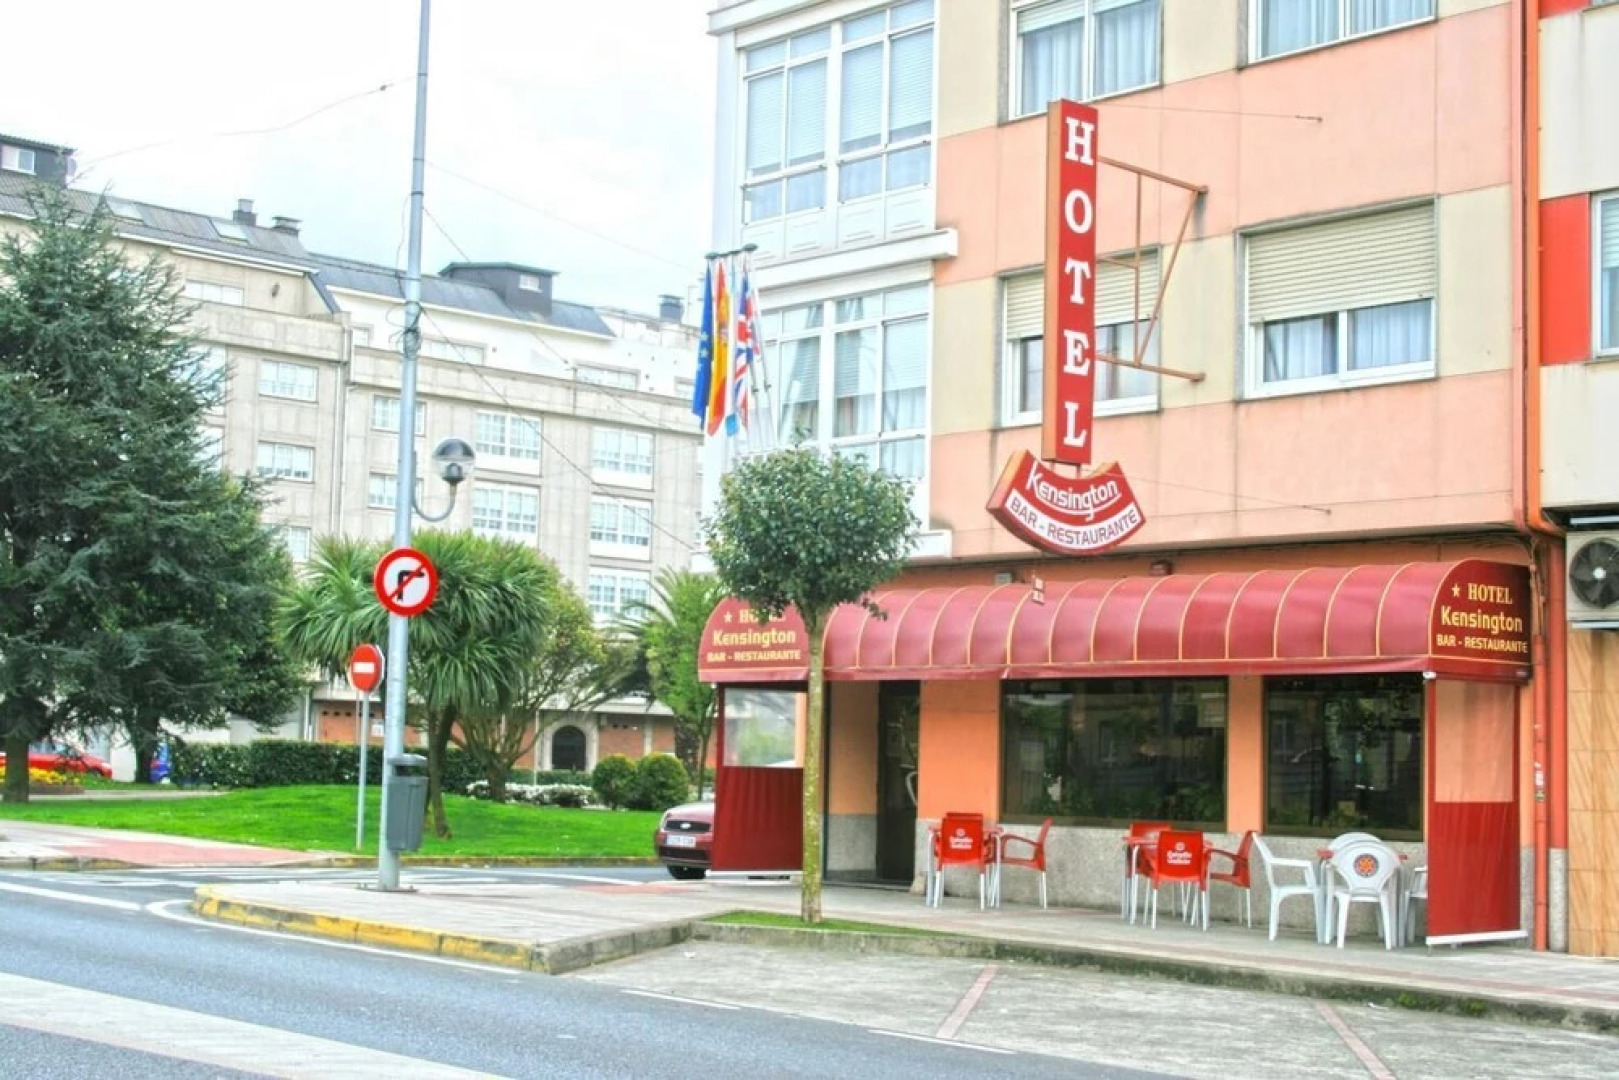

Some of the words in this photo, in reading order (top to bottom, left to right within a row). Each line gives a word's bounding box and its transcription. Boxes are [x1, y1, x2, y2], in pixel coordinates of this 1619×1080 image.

[1063, 116, 1094, 447] HOTEL
[1026, 460, 1121, 521] Kensington
[1010, 497, 1037, 527] BAR
[1047, 510, 1138, 545] RESTAURANTE
[1467, 583, 1513, 604] HOTEL
[739, 609, 786, 623] HOE
[1441, 605, 1523, 635] Kensington
[713, 628, 797, 648] Kensington
[1436, 634, 1456, 647] BAR
[1464, 636, 1528, 653] RESTAURANTE
[707, 652, 726, 662] BAR
[734, 649, 801, 661] RESTAURANTE
